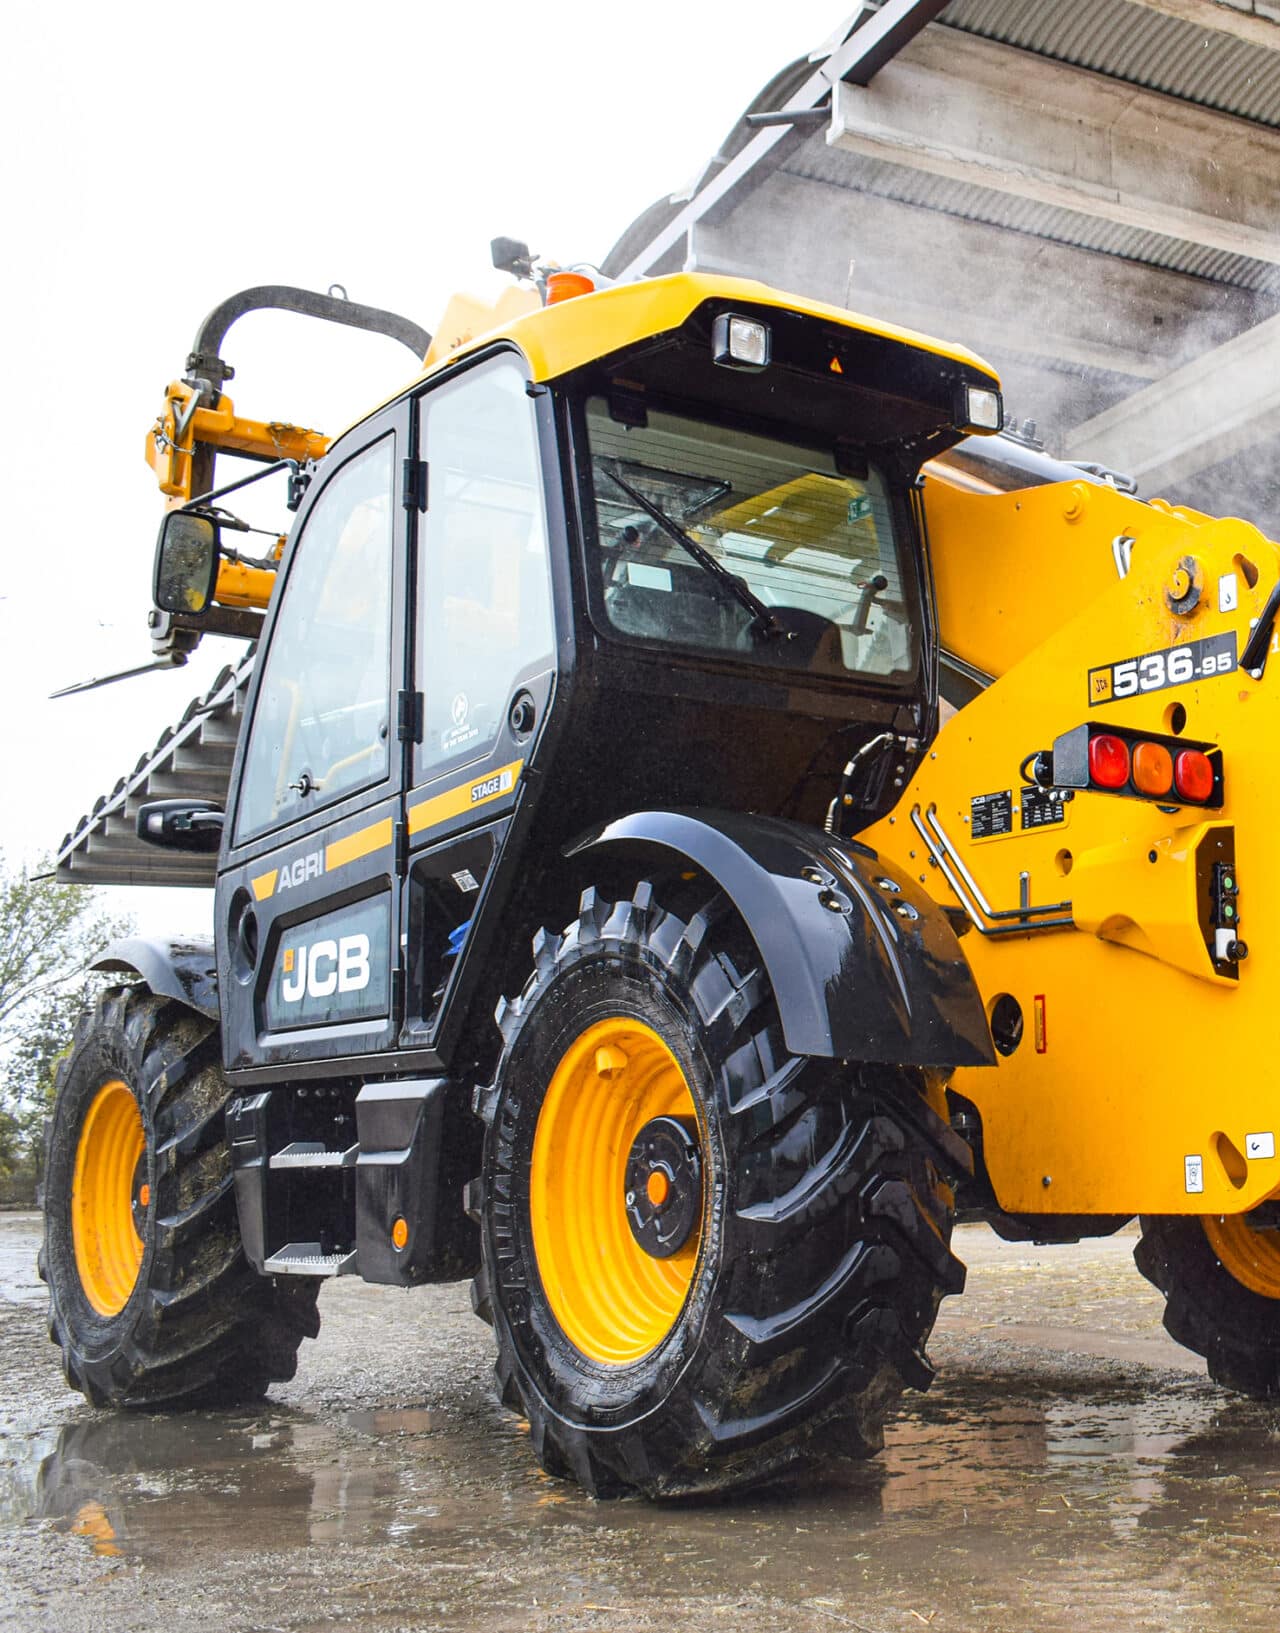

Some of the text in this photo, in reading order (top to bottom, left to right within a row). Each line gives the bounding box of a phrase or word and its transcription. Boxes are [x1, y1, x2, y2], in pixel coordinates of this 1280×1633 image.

[471, 775, 500, 801] STAGE
[277, 849, 324, 894] AGRI
[282, 933, 370, 1003] JCB
